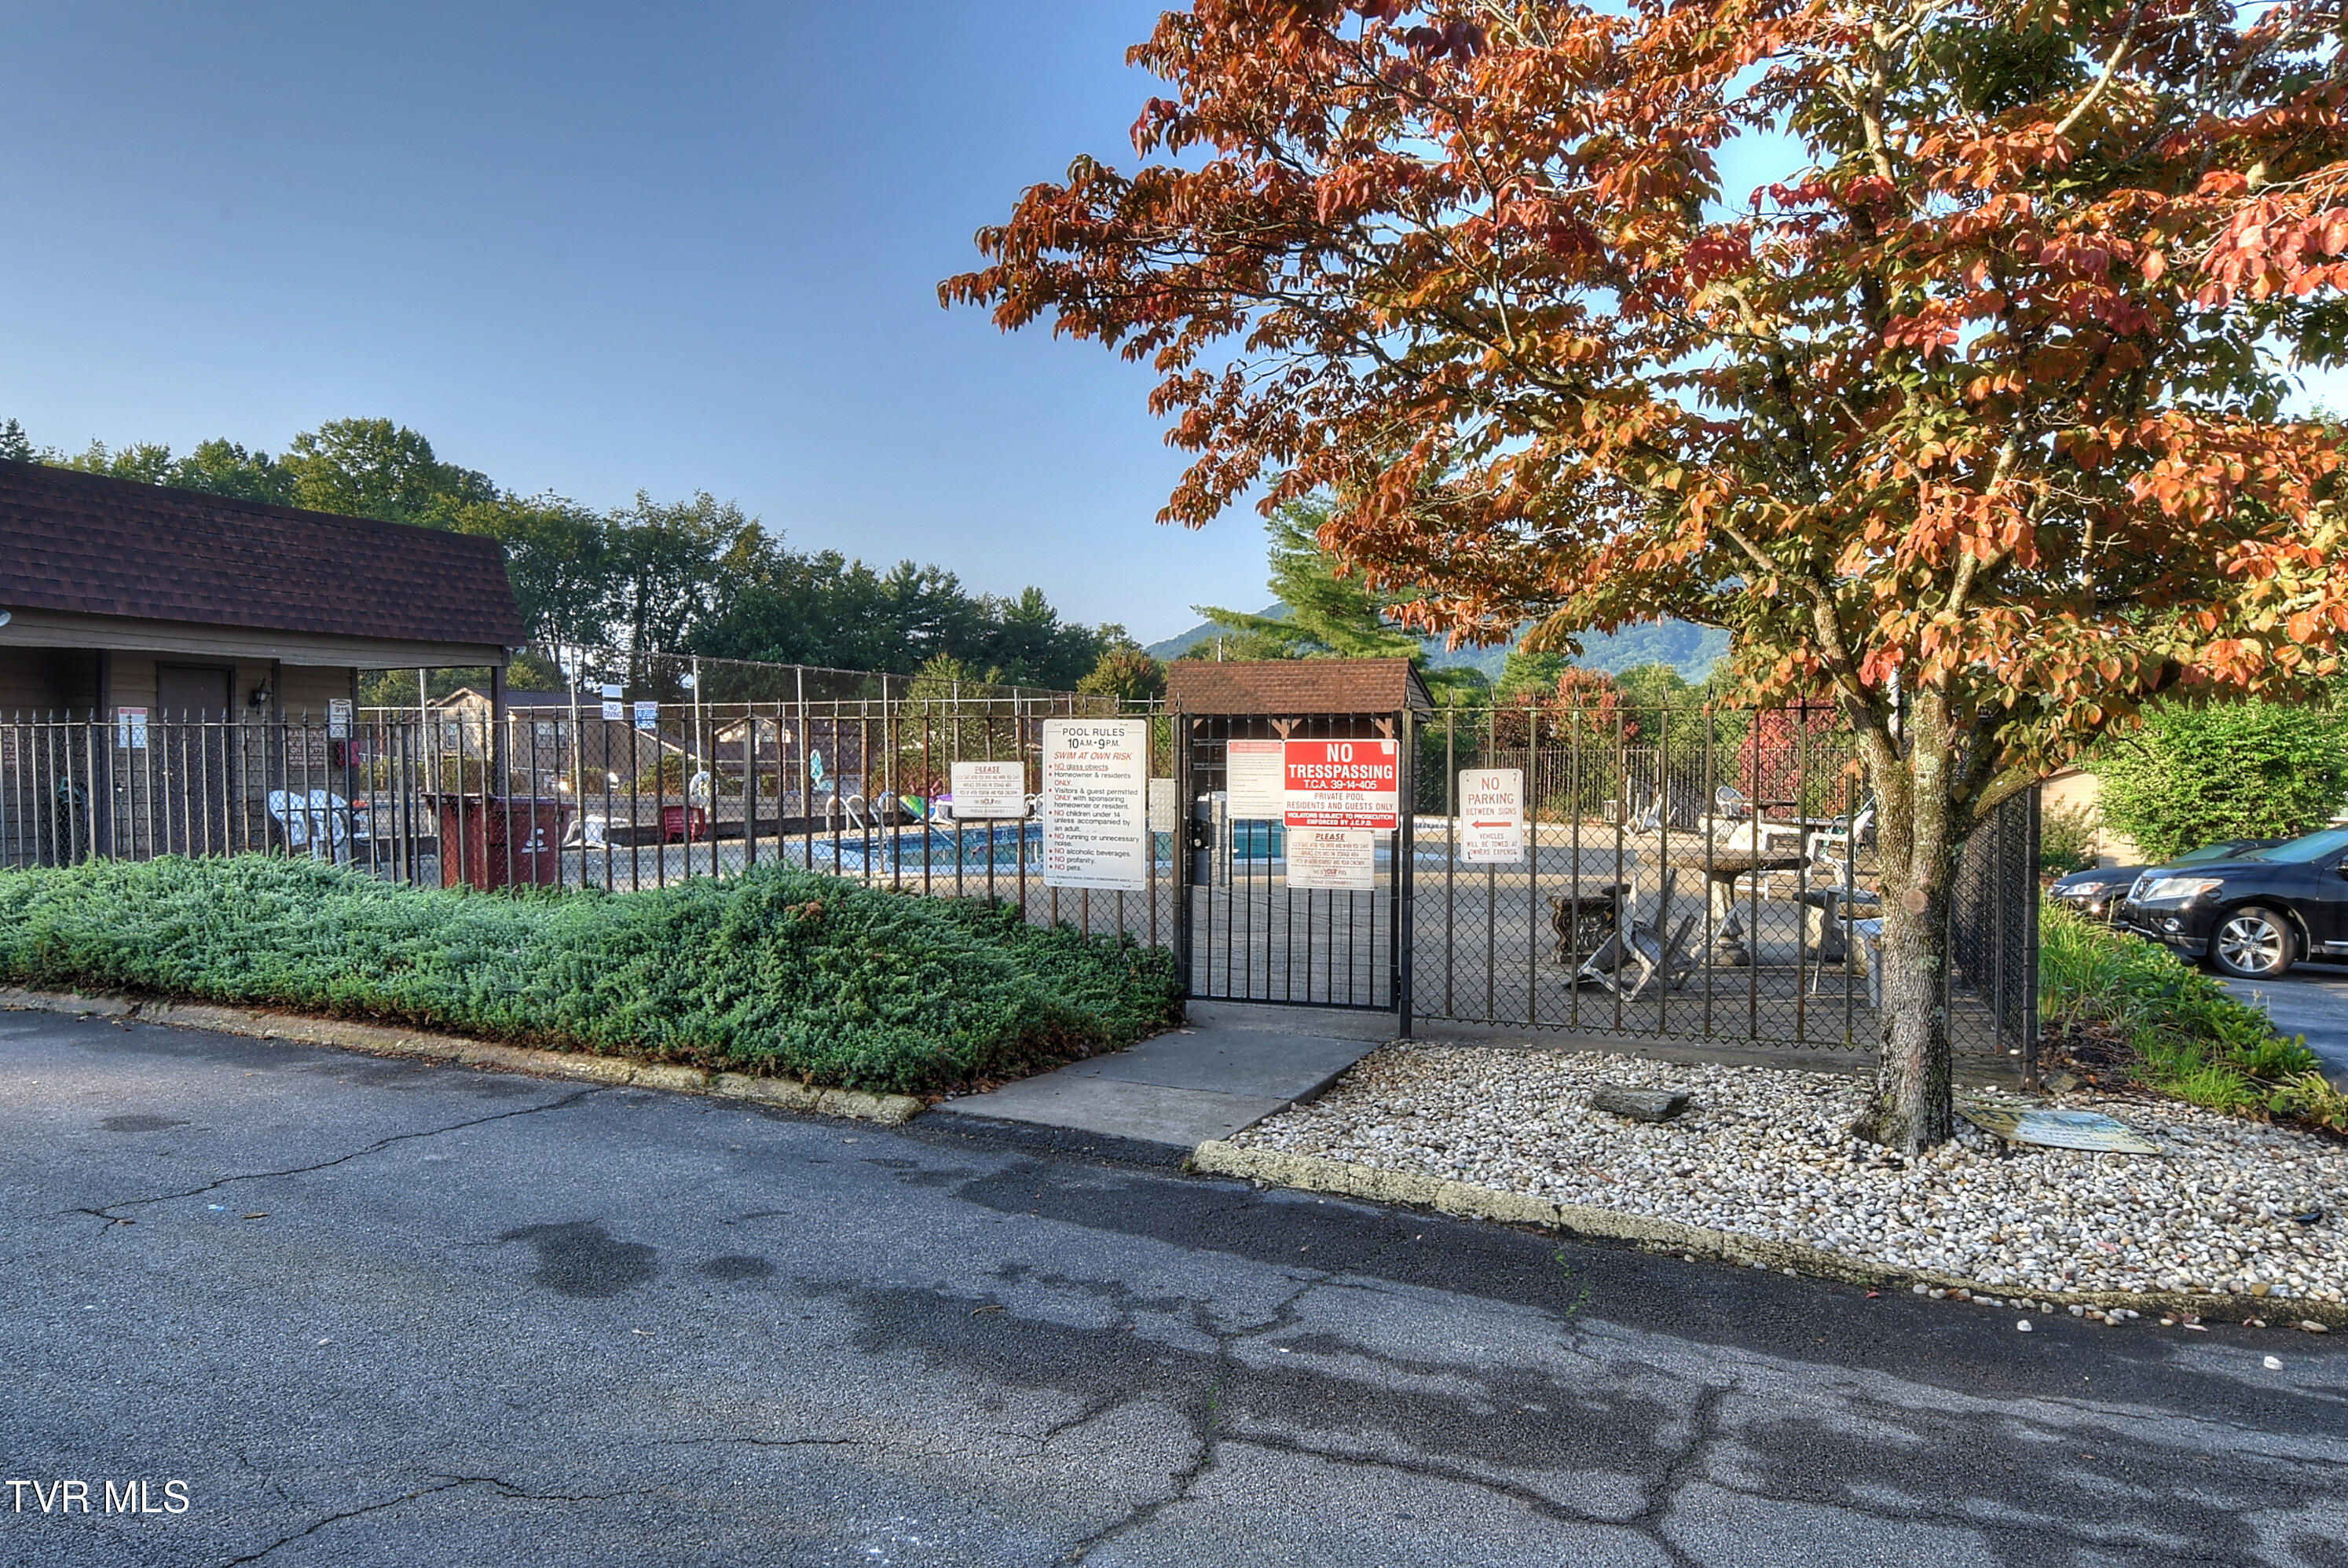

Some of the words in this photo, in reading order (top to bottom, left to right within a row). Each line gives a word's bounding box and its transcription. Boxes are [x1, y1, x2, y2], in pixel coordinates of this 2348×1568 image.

[1053, 751, 1075, 760] SWIM
[1326, 743, 1353, 763] NO
[1288, 764, 1393, 779] TRESSPASSING
[1303, 779, 1328, 789] T.C.A.
[1331, 780, 1376, 789] 39-14-405
[1482, 777, 1500, 790] NO
[1468, 793, 1514, 804] PARKING
[1315, 833, 1346, 841] PLEASE
